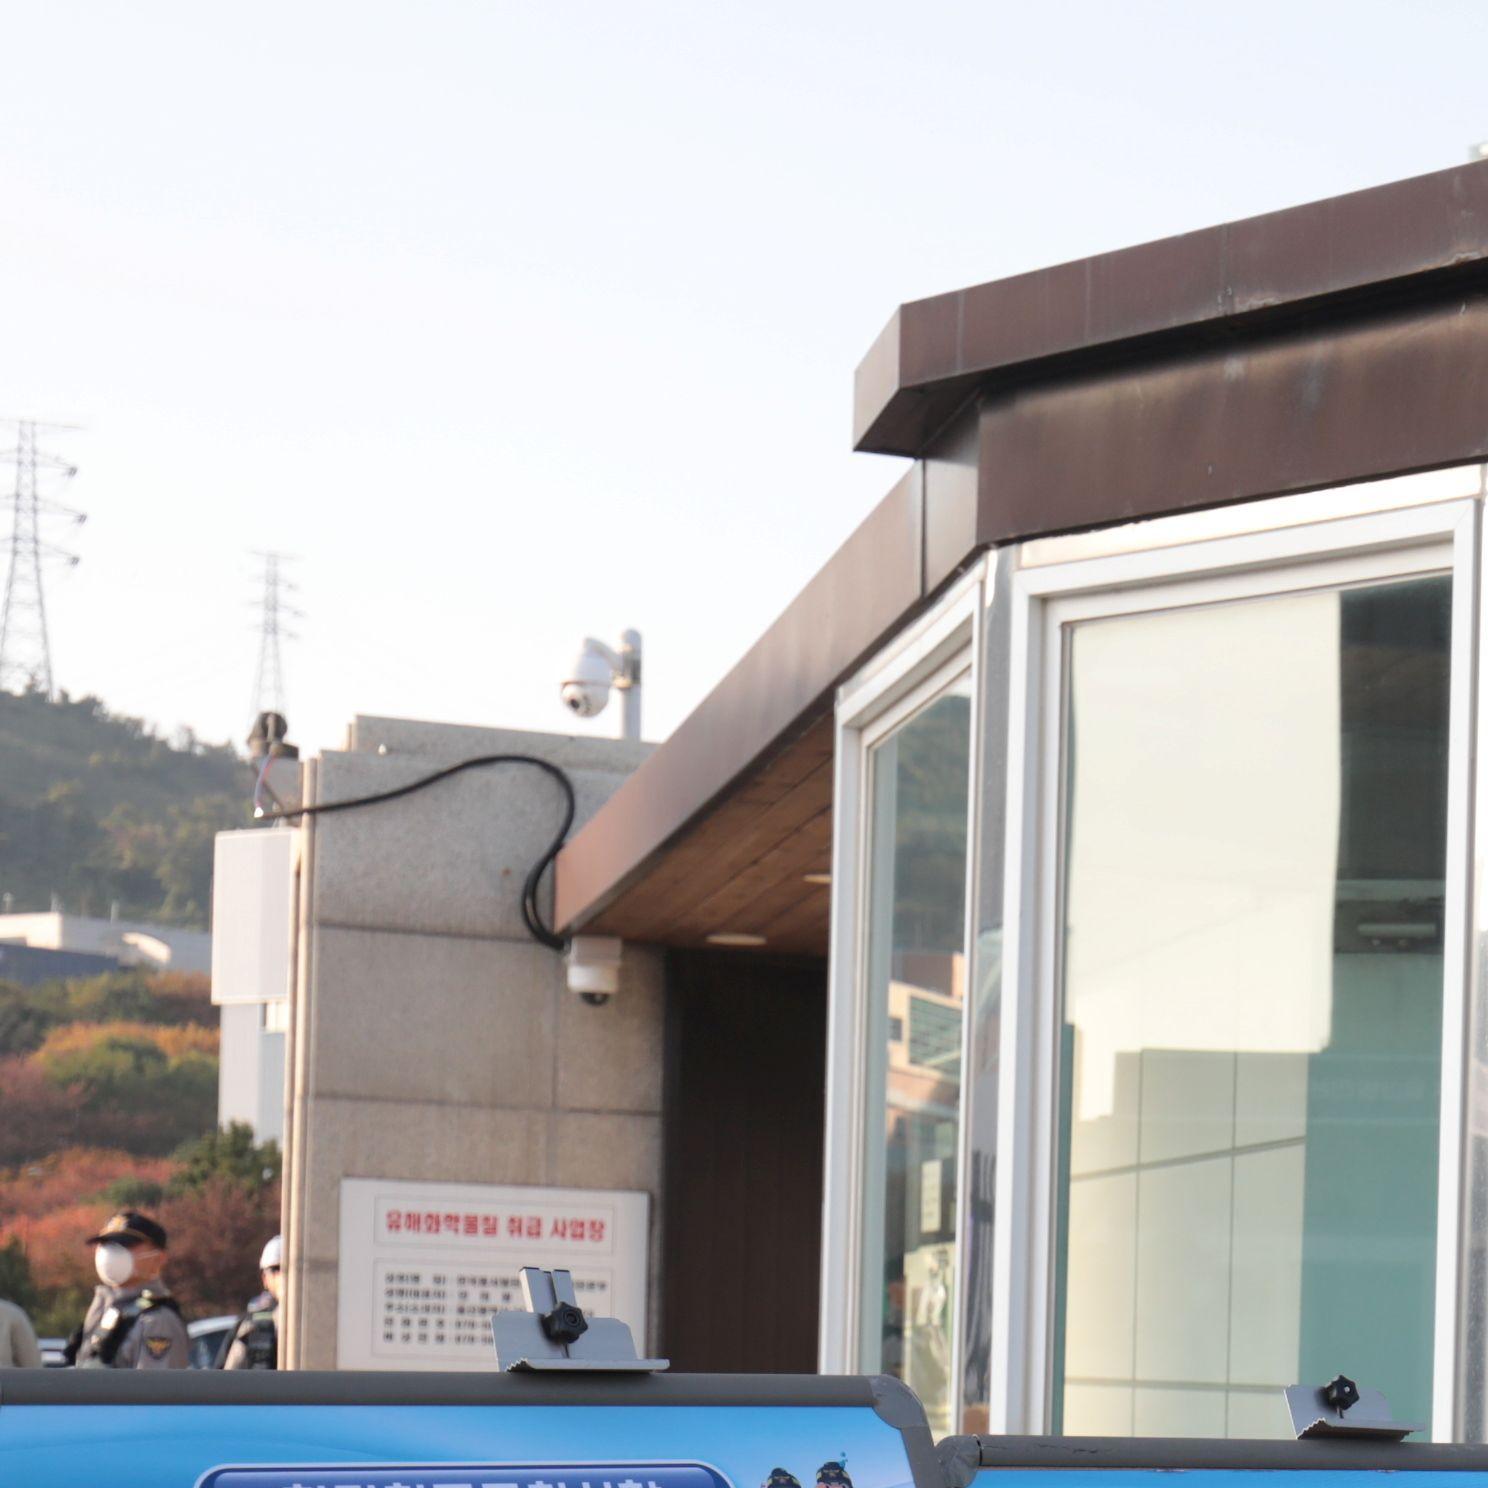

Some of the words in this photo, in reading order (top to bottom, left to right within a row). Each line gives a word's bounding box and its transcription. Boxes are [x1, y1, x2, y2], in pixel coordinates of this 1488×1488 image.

[387, 1210, 499, 1236] 유해화학물질
[507, 1216, 541, 1238] 취급
[551, 1218, 606, 1242] 사업장
